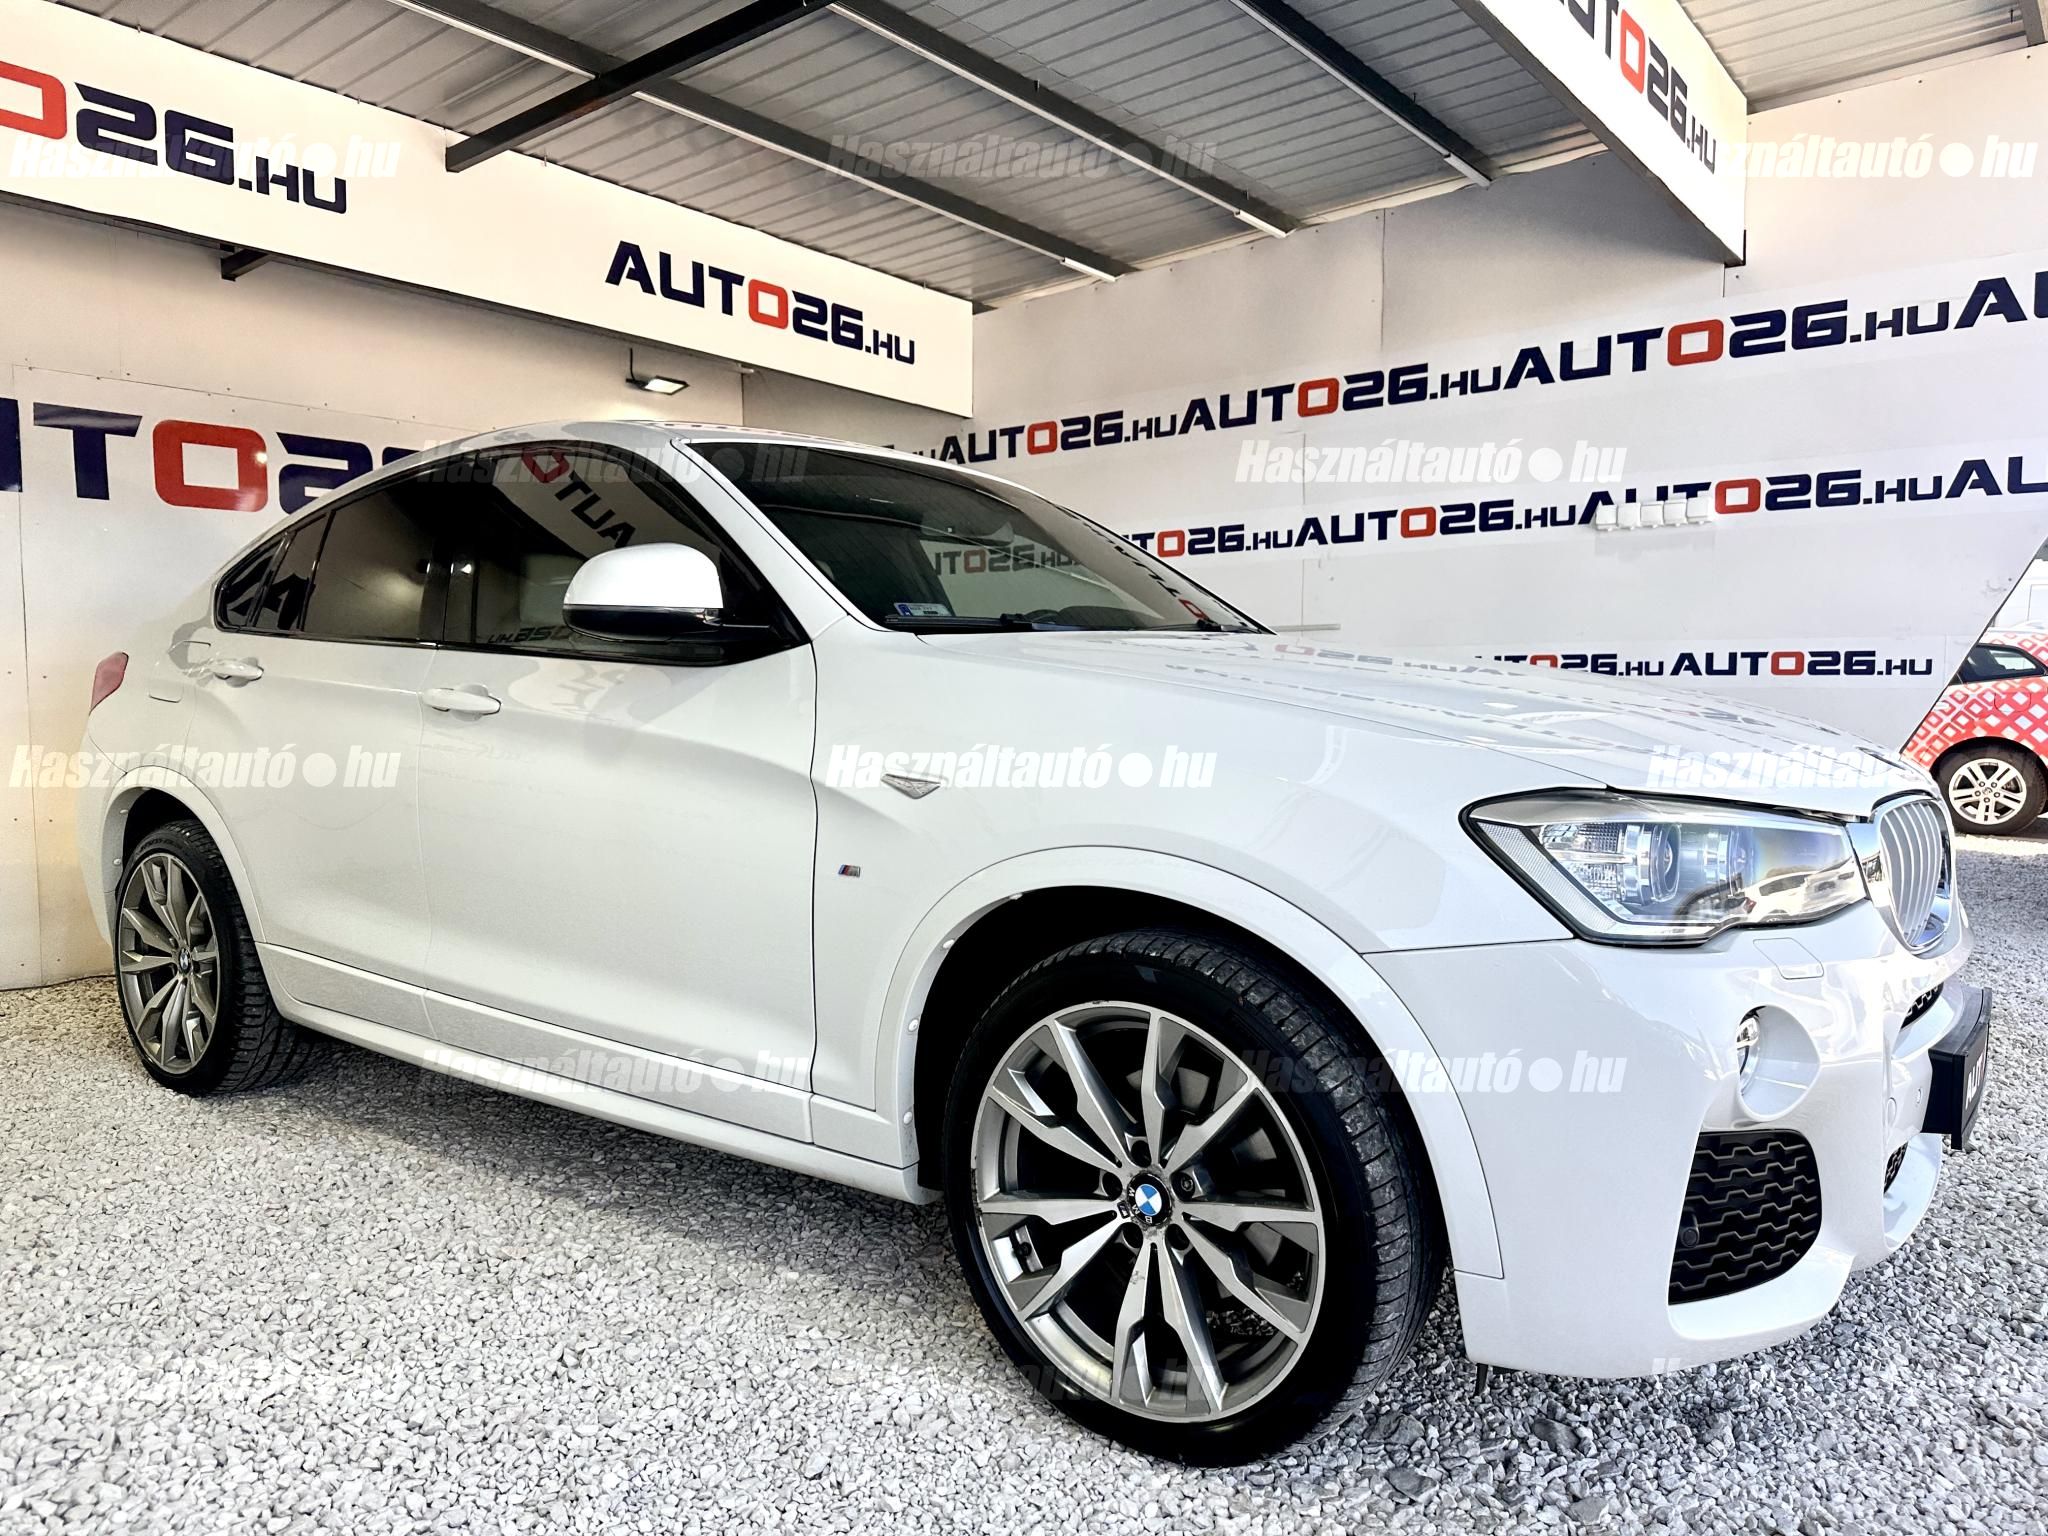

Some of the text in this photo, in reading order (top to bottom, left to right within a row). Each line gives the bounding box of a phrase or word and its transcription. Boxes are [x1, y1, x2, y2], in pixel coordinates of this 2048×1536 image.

[605, 240, 915, 365] AUTO26.HU
[939, 271, 2048, 465] AUTO26.HU AUTO26.HU AUTO26.HU A
[1121, 523, 1293, 558] TO26.HU
[1294, 498, 1576, 547] AUTO26.HU
[1670, 650, 1933, 676] AUTO26.HU
